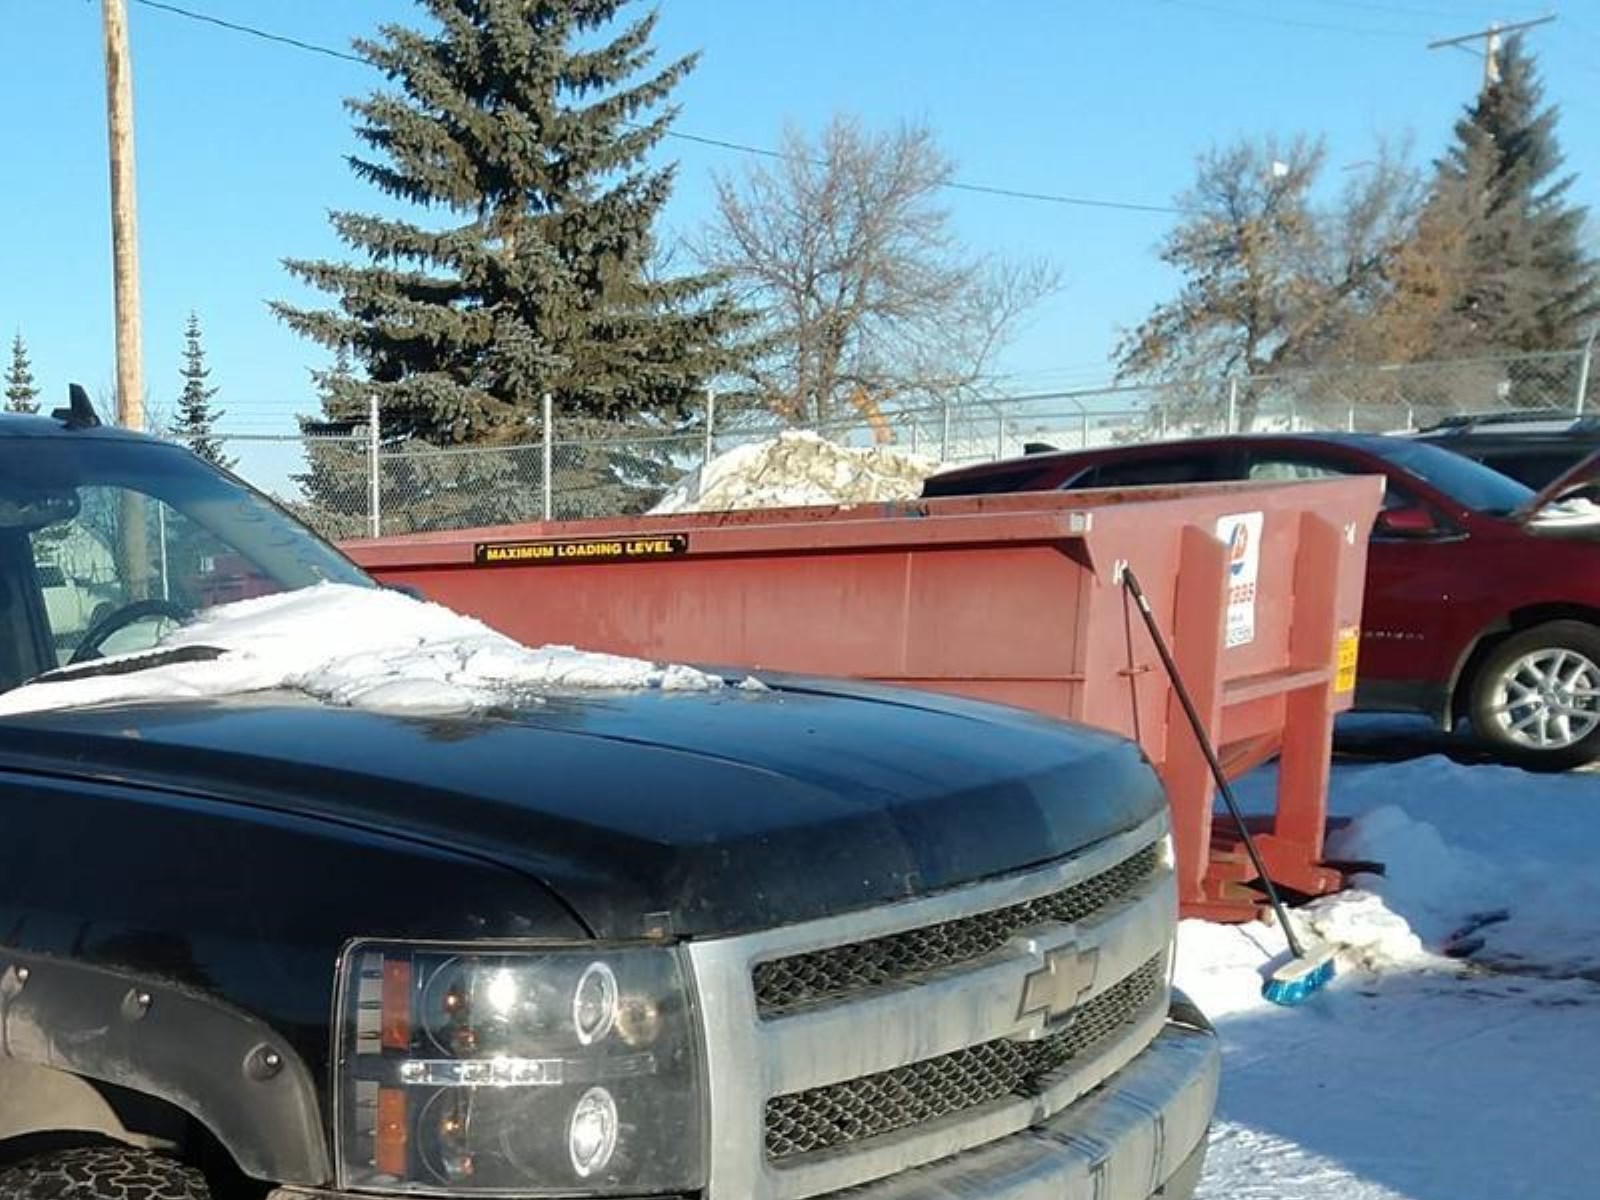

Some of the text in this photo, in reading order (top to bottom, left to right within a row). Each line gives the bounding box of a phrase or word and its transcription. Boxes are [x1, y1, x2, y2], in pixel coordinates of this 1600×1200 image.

[486, 540, 674, 561] MAXIMUM LOADING LEVEL
